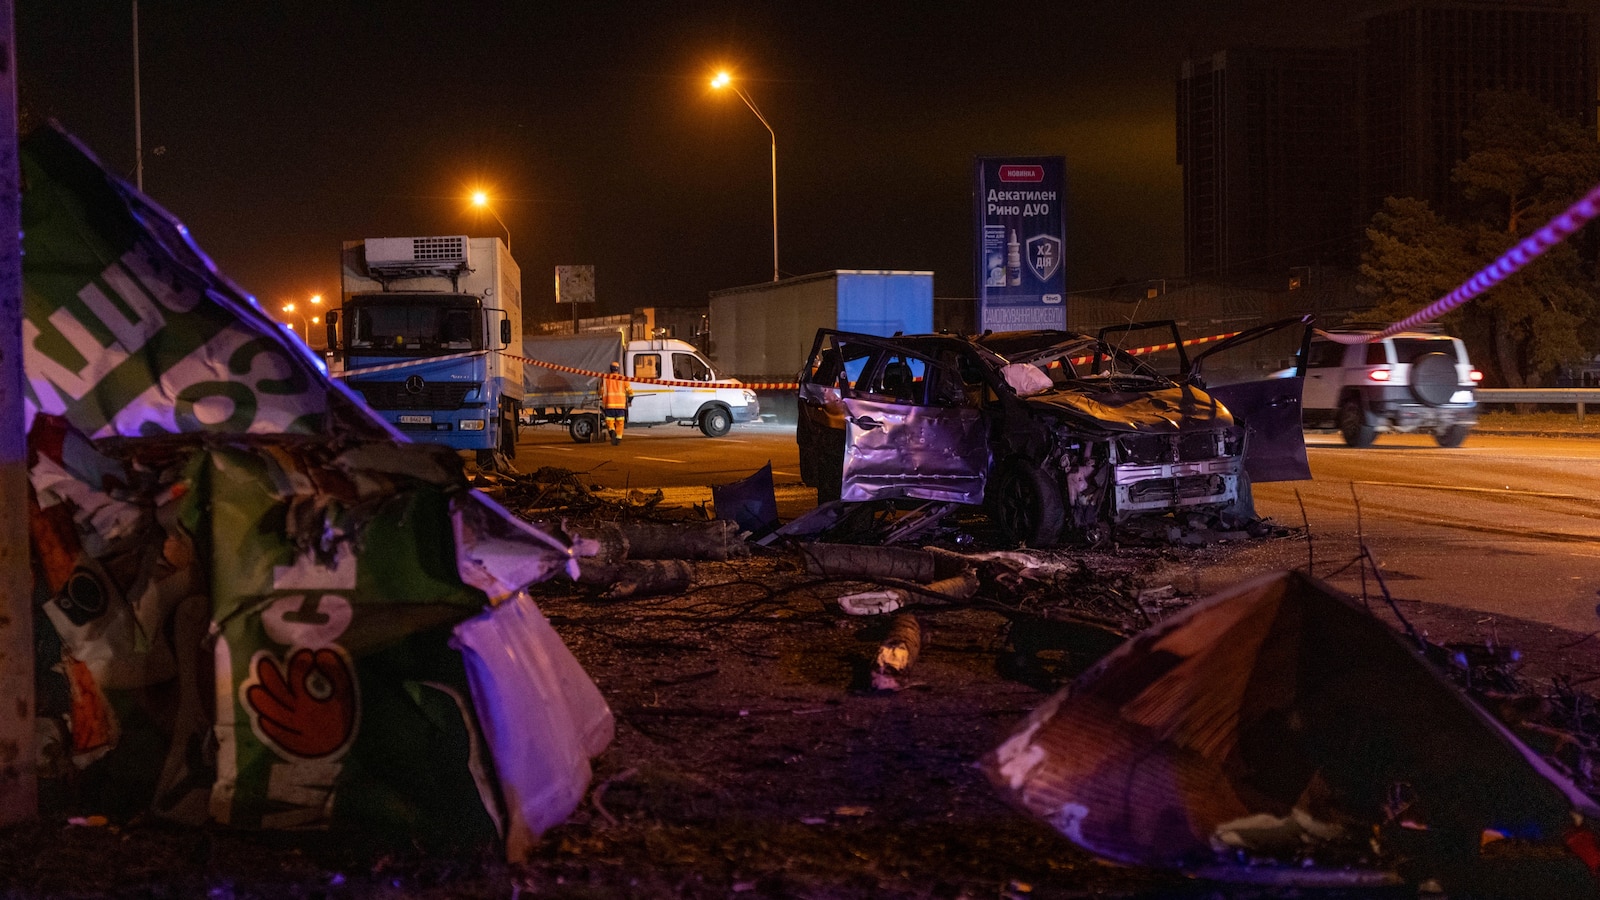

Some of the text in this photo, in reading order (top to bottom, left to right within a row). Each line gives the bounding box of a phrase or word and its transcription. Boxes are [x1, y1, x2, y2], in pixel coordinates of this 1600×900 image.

[1007, 170, 1036, 178] НОВИНКА
[987, 188, 1057, 203] Декатилен
[988, 203, 1050, 217] Рино ДУО
[1035, 257, 1052, 270] ДІЯ
